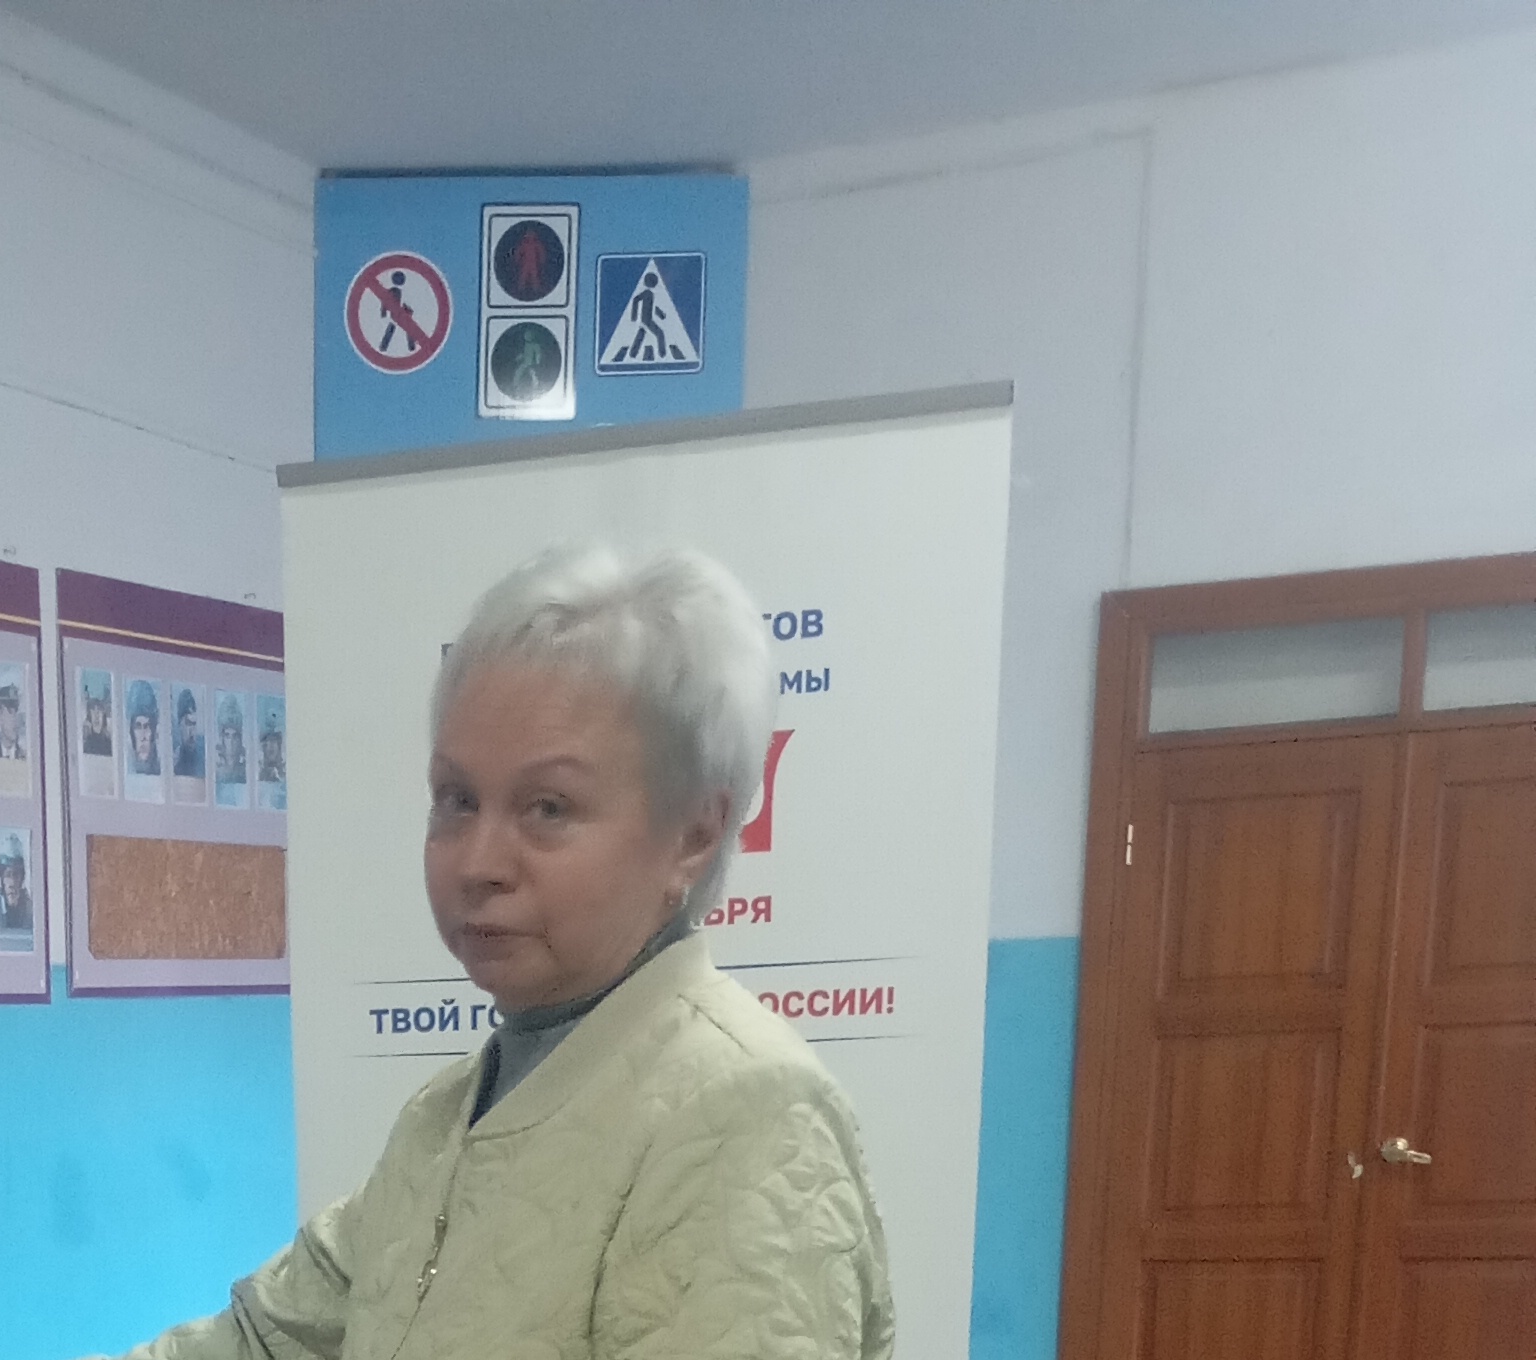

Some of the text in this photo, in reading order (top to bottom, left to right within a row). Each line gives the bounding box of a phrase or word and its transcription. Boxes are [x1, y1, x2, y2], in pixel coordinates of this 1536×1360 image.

[762, 608, 824, 641] ОВ
[779, 667, 830, 695] МЫ
[369, 998, 460, 1034] ТВОЙ
